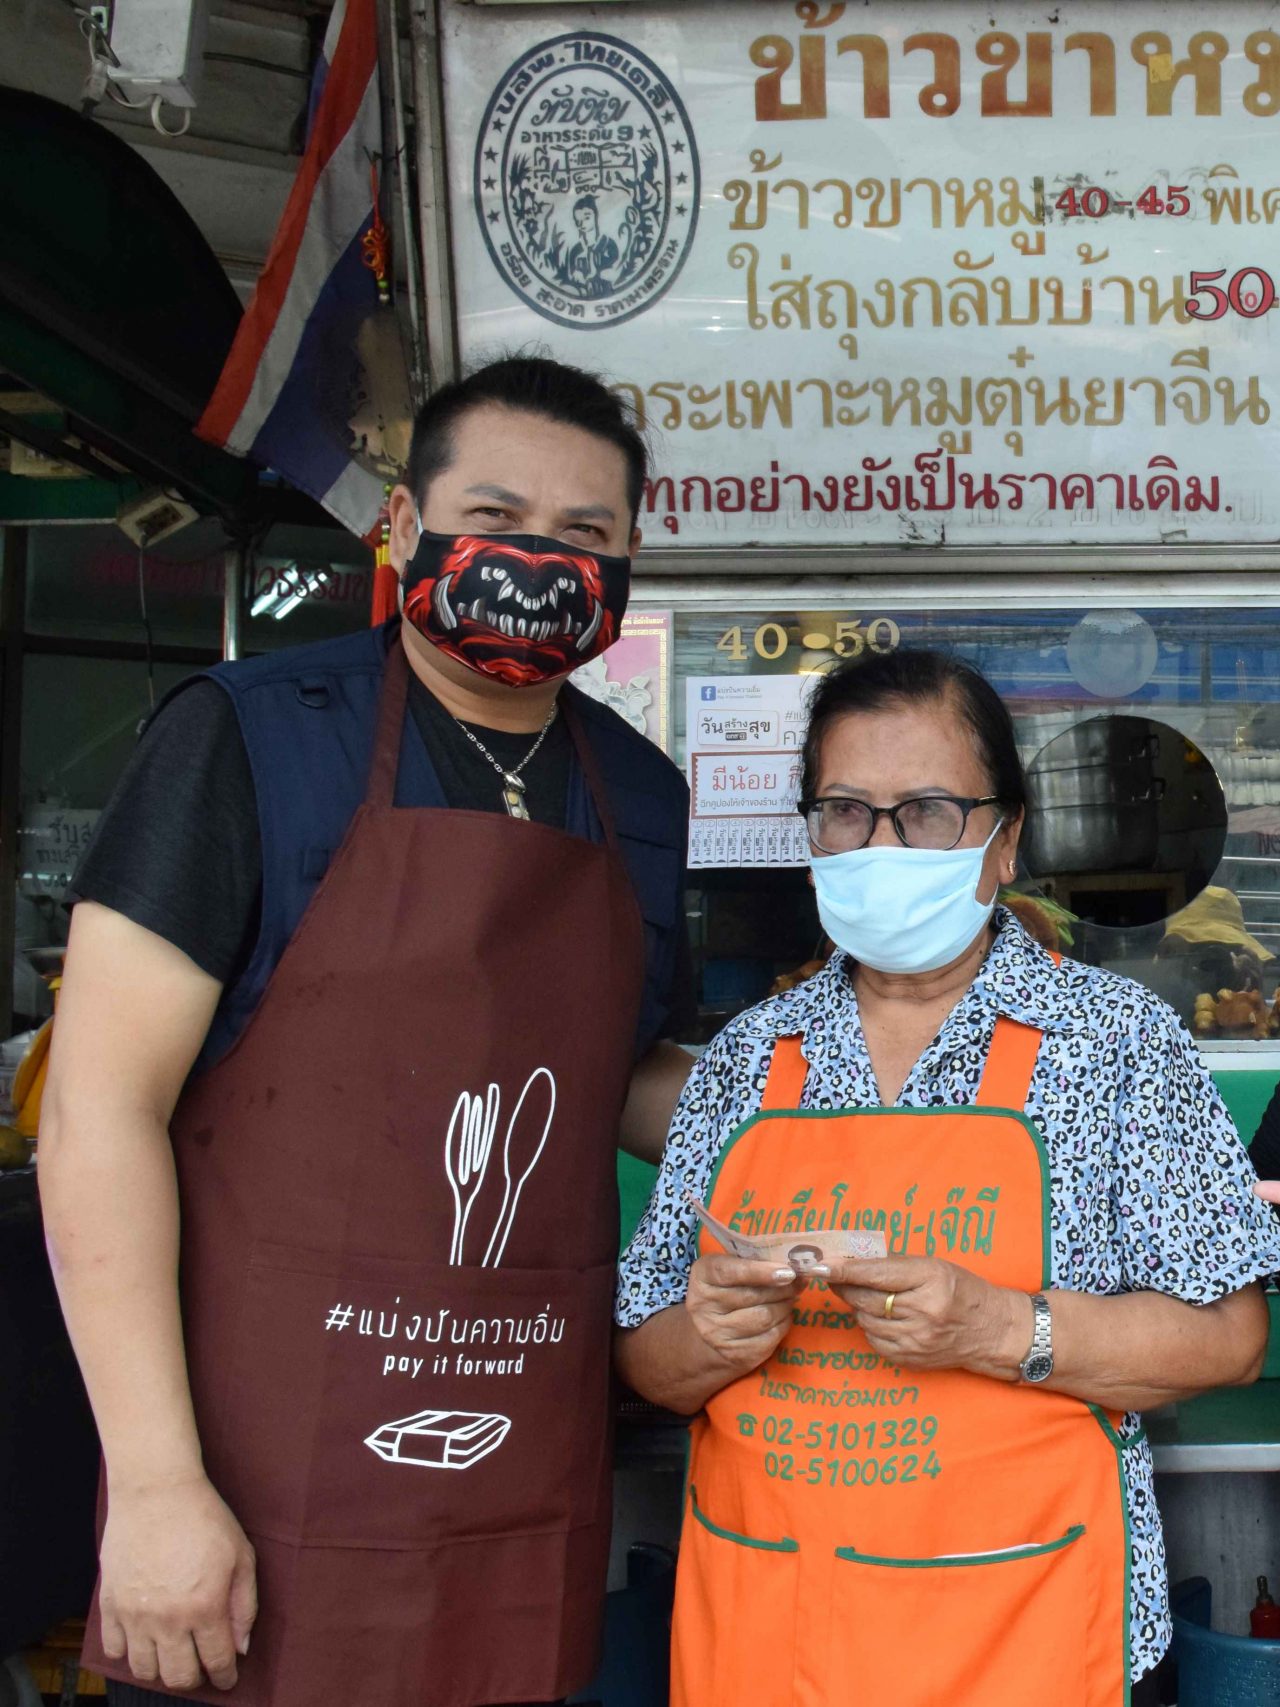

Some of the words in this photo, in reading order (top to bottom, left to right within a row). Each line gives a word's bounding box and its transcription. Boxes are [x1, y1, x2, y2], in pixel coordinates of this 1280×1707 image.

[726, 243, 1193, 360] ใส่ถุงกลับบ้าน
[325, 1297, 566, 1344] #แบ่งปันความอิ่ม
[383, 1353, 424, 1378] pay
[433, 1353, 448, 1374] it
[456, 1353, 524, 1376] forward
[763, 1415, 939, 1450] 02-5101329
[765, 1451, 941, 1487] 02-5100624
